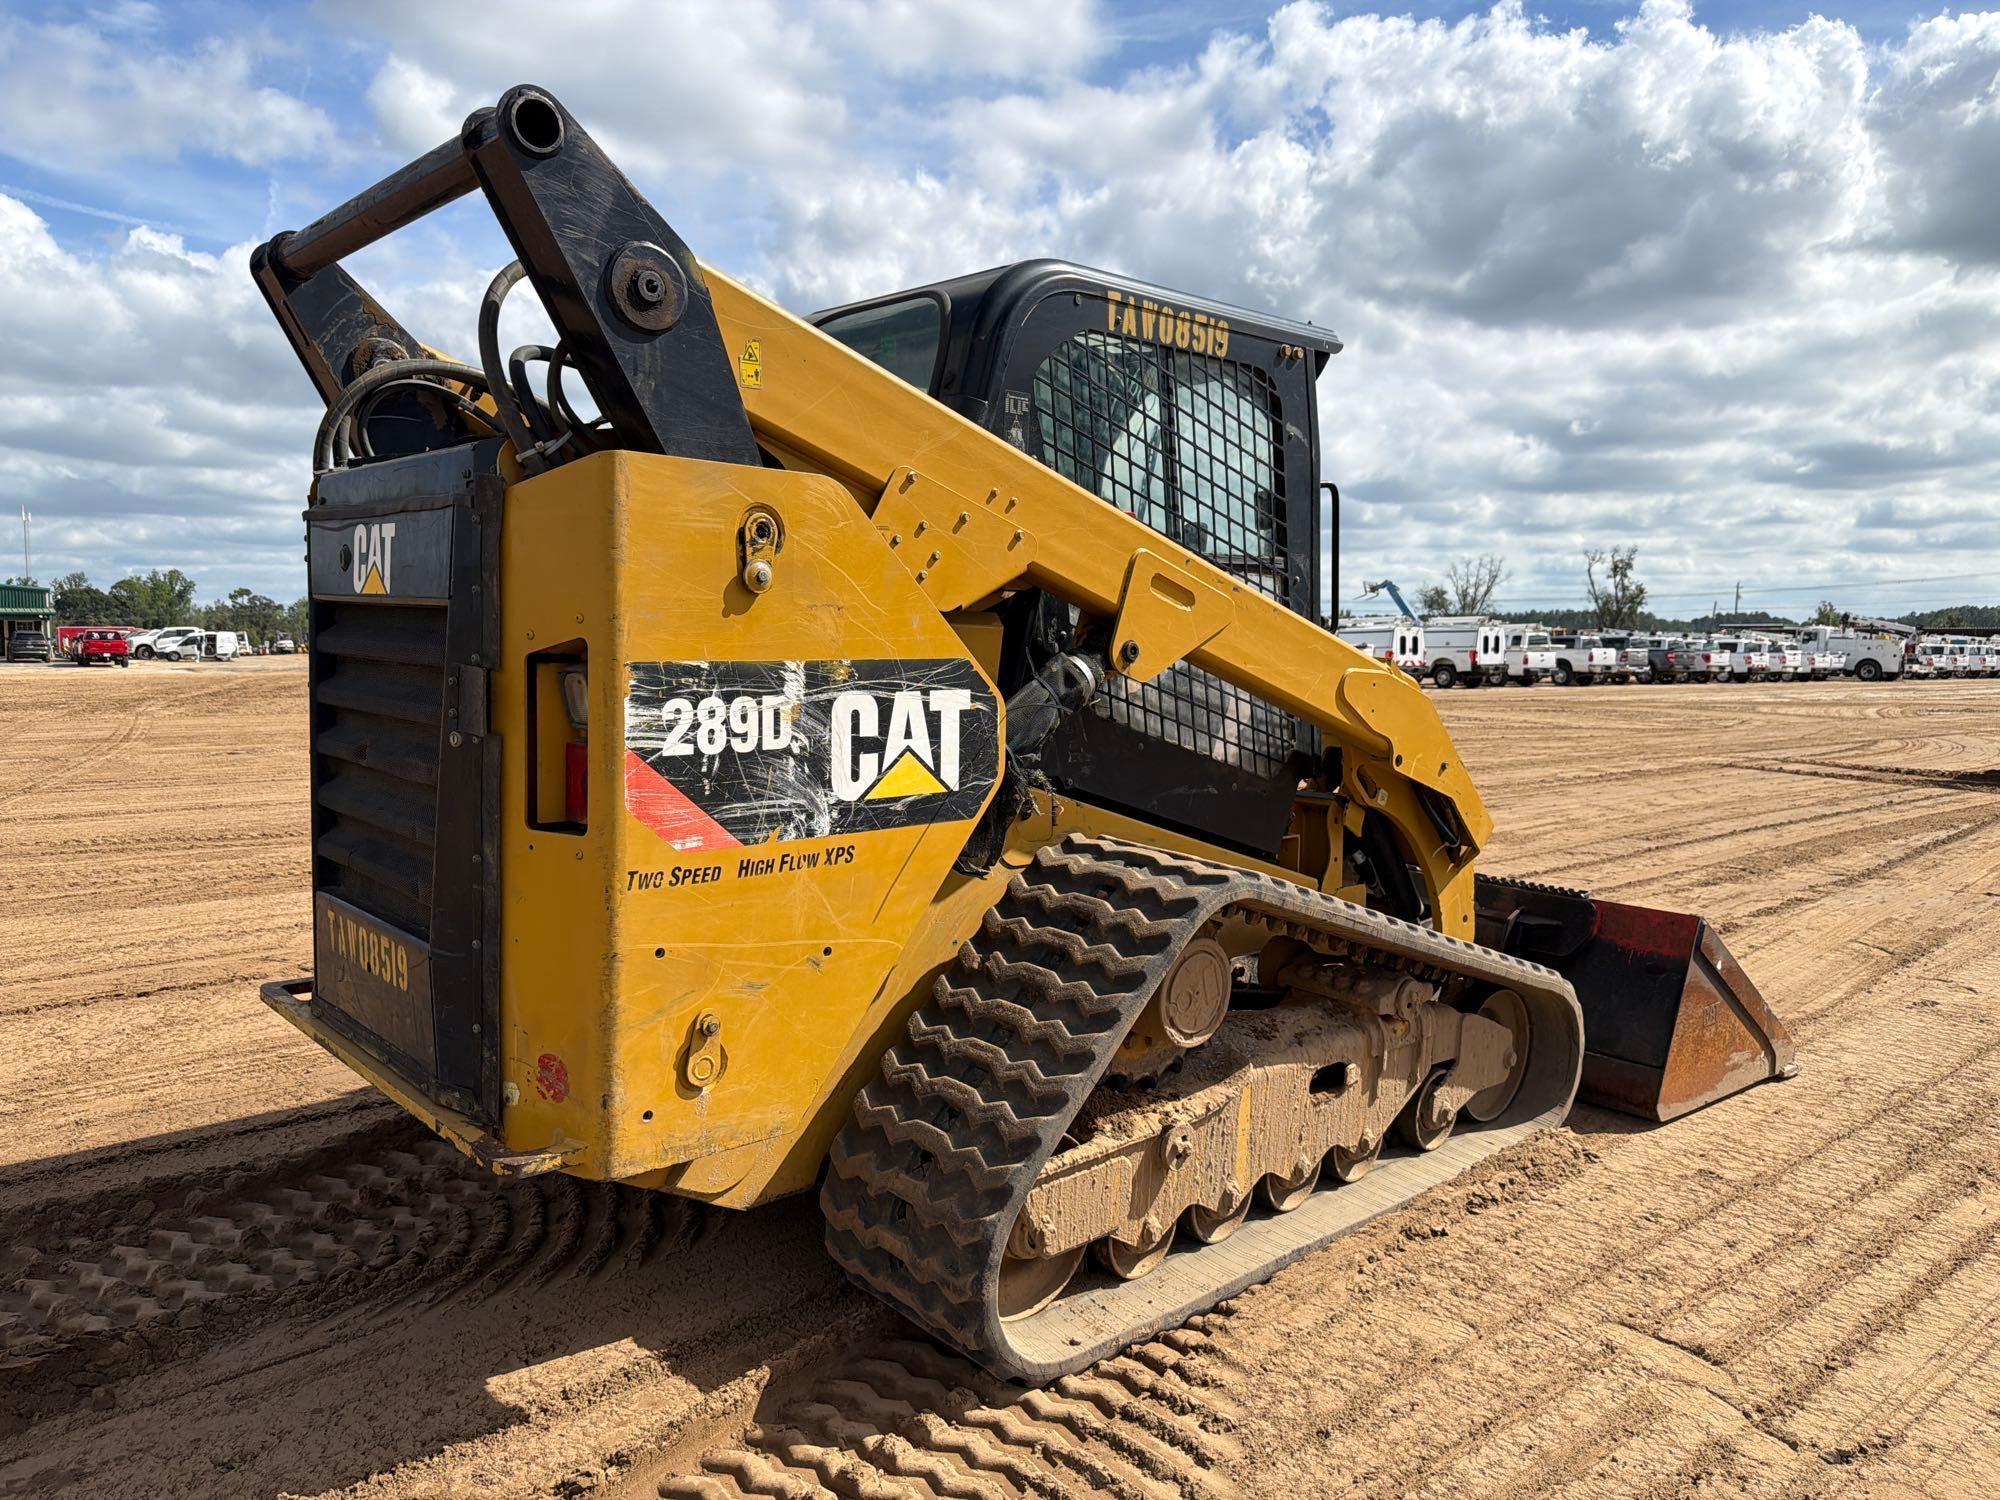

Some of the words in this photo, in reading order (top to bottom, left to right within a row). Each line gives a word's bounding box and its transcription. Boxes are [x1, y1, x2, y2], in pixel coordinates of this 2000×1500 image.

[1107, 290, 1229, 357] TAW08519
[353, 523, 395, 594] CAT
[661, 695, 792, 756] 289D
[831, 689, 971, 802] CAT
[824, 845, 855, 865] XPS
[327, 909, 408, 992] TAW08519
